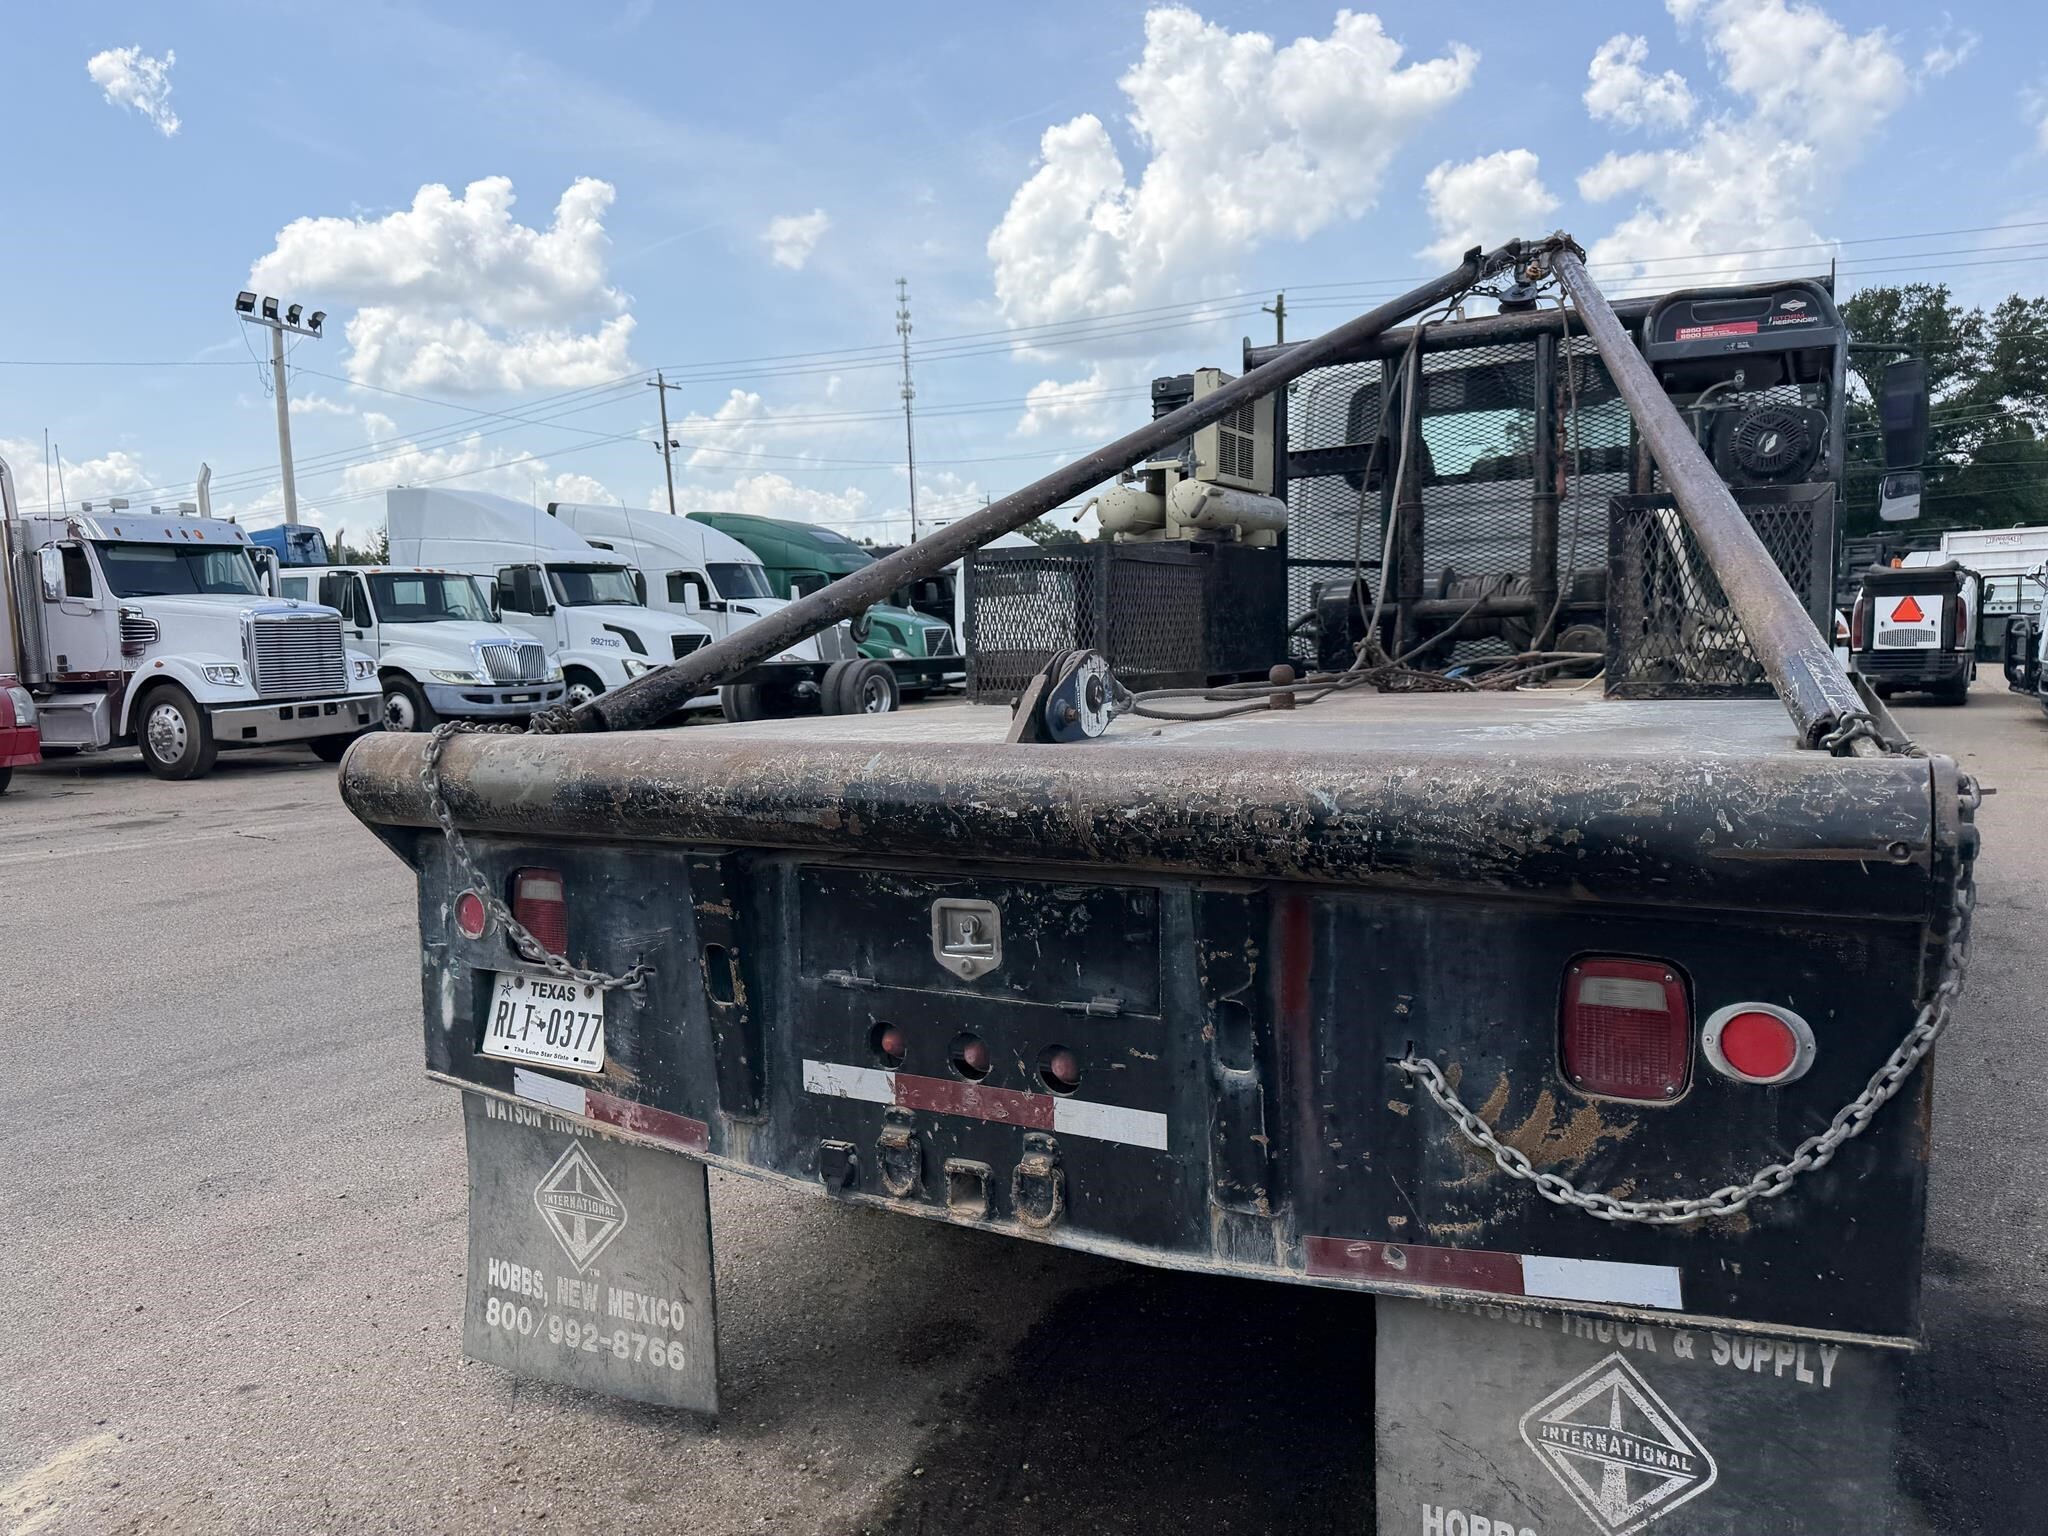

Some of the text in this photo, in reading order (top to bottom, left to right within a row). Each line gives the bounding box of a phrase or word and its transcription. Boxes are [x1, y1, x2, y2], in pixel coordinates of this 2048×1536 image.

[590, 637, 620, 648] 9921136
[530, 981, 576, 1003] TEXAS
[526, 1047, 540, 1056] Lone
[541, 1050, 553, 1058] Star
[554, 1053, 570, 1061] State
[544, 1193, 616, 1217] INTERNATIONAL
[488, 1257, 685, 1331] HOBBS, NEW MEXICO
[486, 1296, 685, 1371] 800/992-8766
[1673, 1329, 1695, 1360] &
[1711, 1330, 1842, 1388] SUPPLY
[1542, 1424, 1692, 1472] INTERNATIONAL
